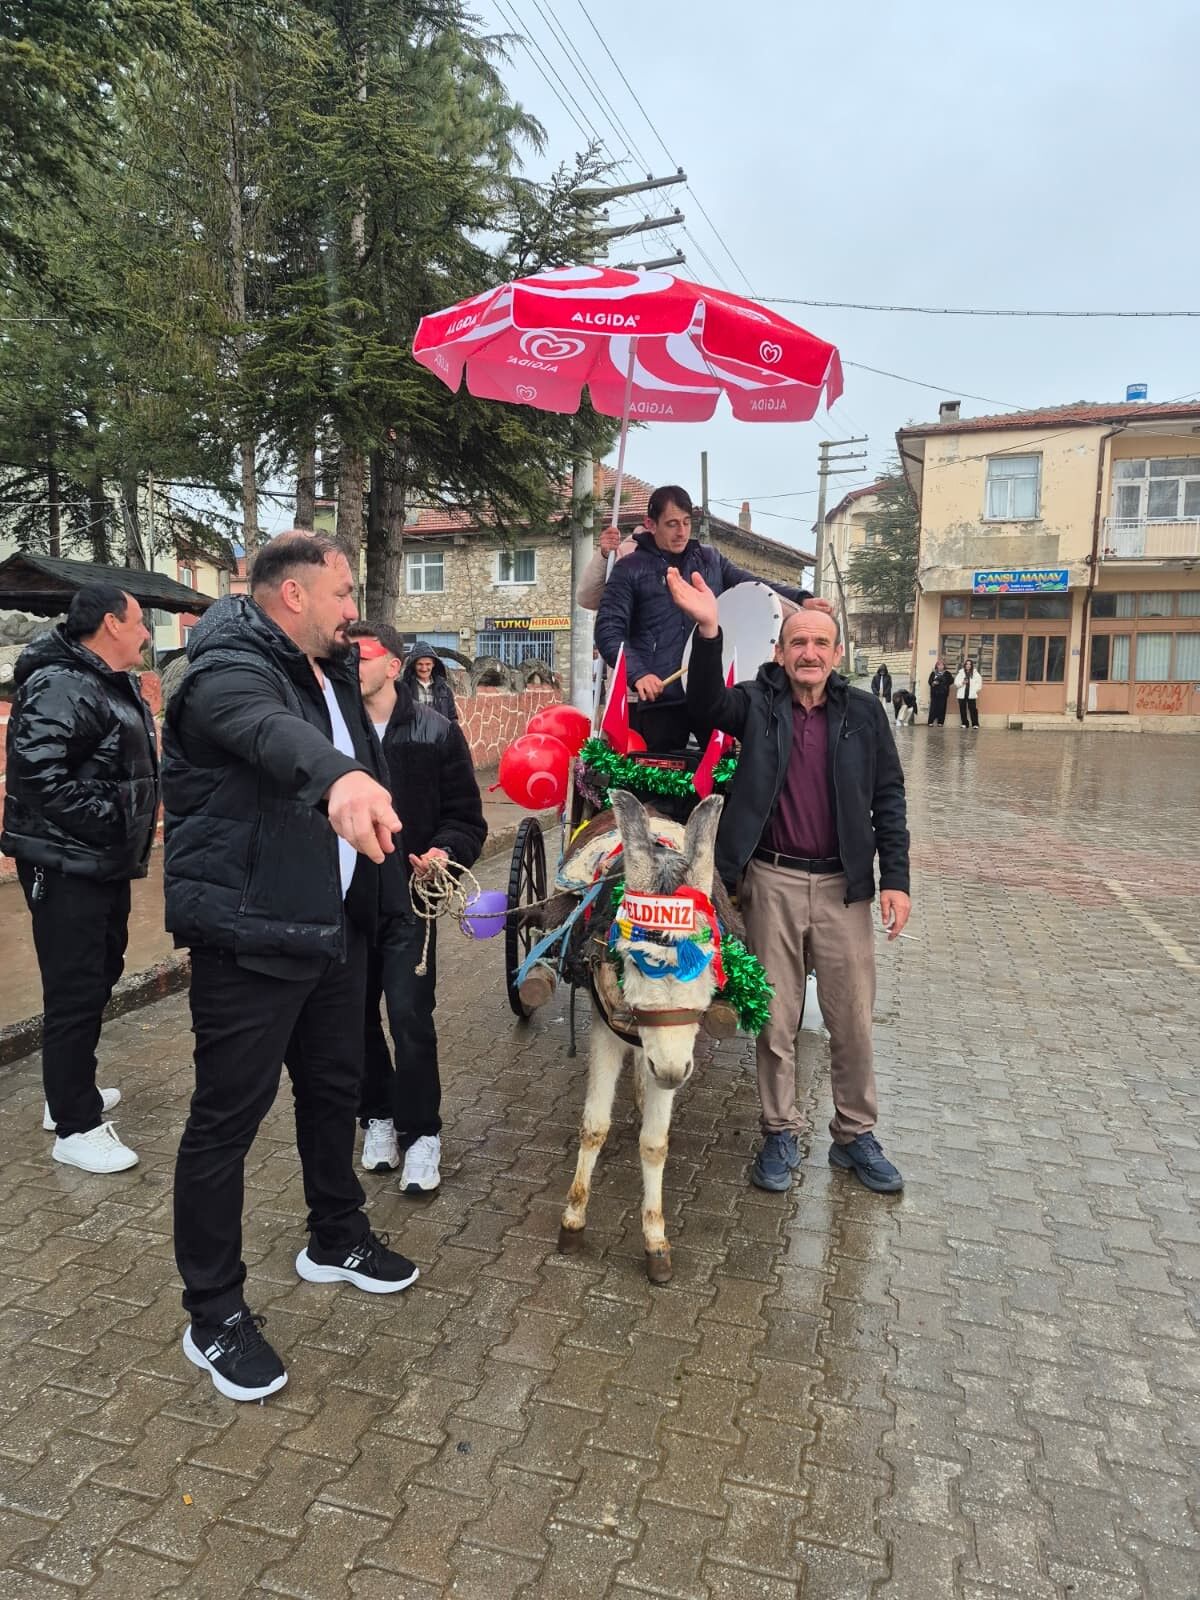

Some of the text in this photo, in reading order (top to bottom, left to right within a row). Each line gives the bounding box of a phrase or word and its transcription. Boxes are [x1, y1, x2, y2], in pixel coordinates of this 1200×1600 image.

[571, 311, 637, 328] ALGIDA
[977, 572, 1063, 583] CANSU MANAV
[494, 618, 570, 629] TUTKU HIRDAVA
[622, 900, 691, 925] ELDİNİZ
